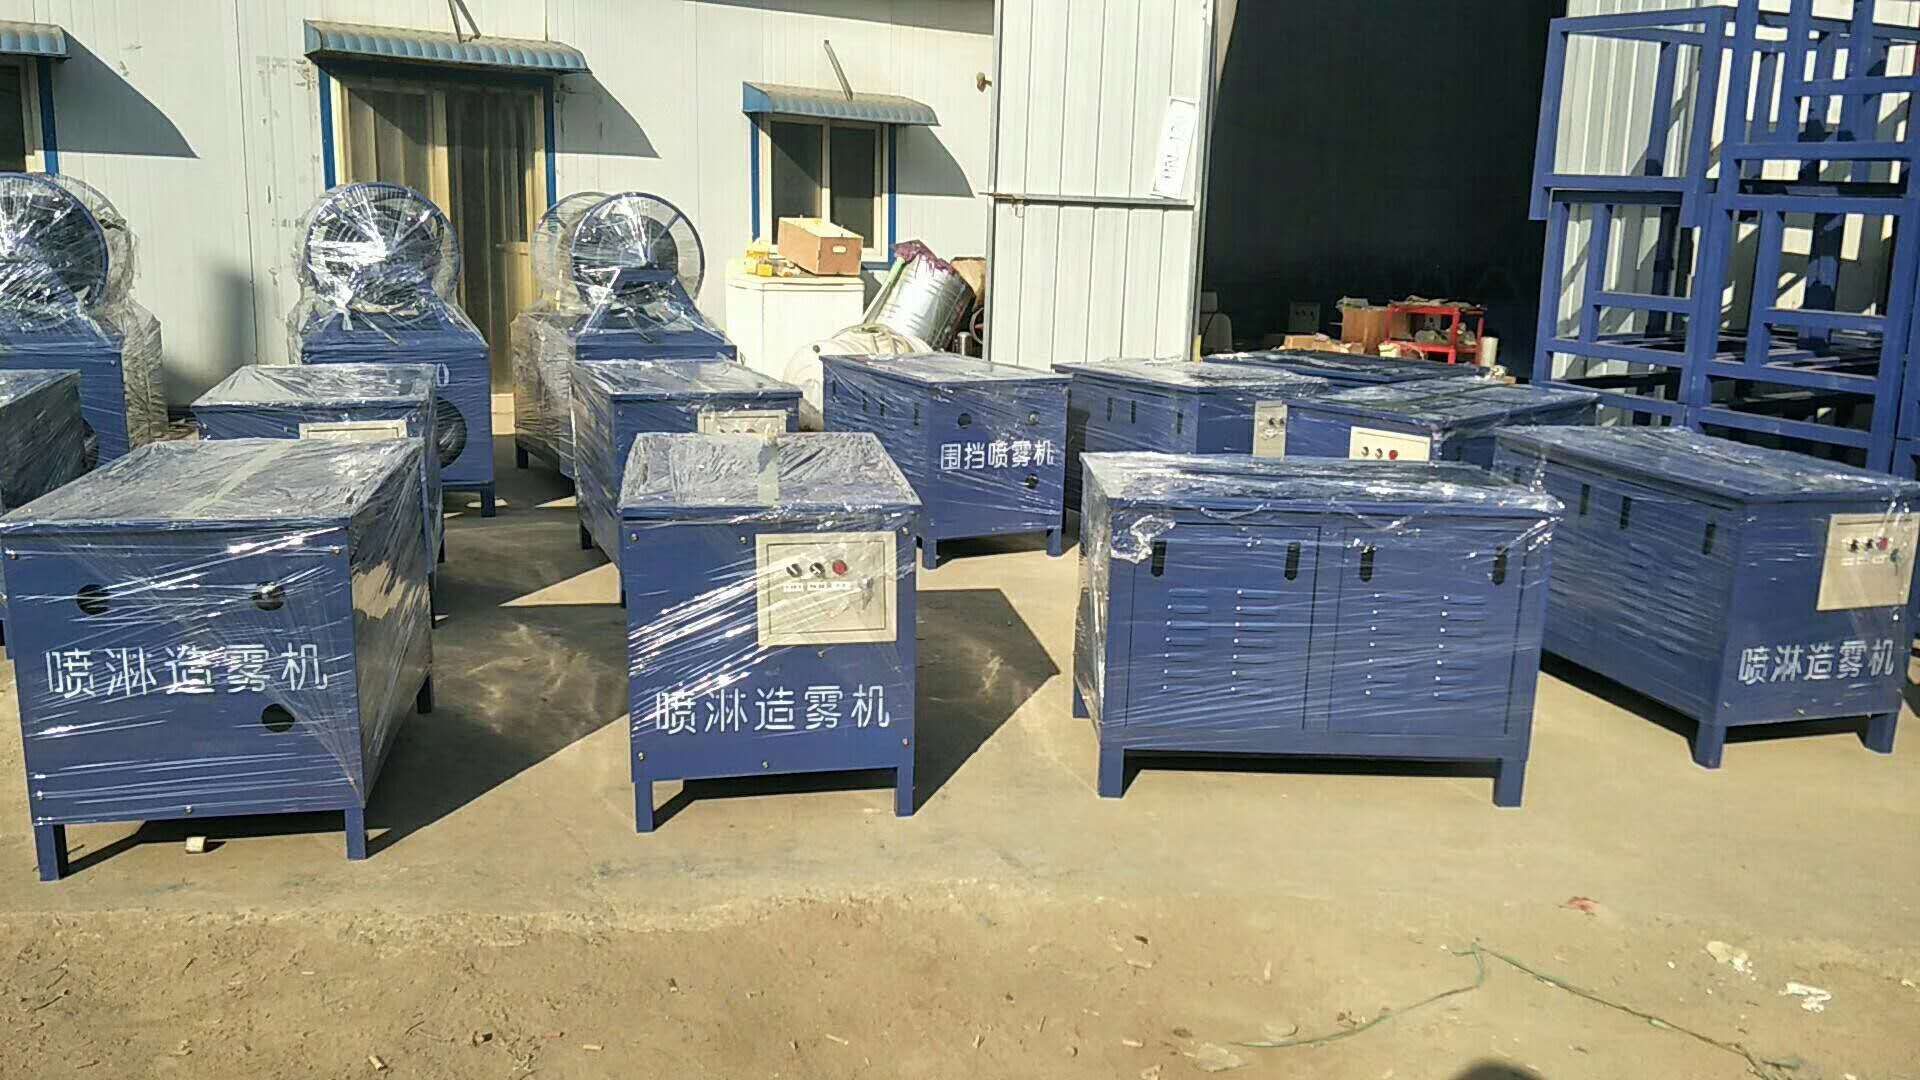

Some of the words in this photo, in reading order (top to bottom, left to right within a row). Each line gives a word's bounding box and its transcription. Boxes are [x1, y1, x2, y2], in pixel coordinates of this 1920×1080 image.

[940, 439, 1055, 472] 围挡喷雾机
[46, 643, 328, 698] 喷淋造雾机
[1738, 639, 1895, 686] 喷淋造雾机
[655, 685, 889, 735] 喷淋造雾机
